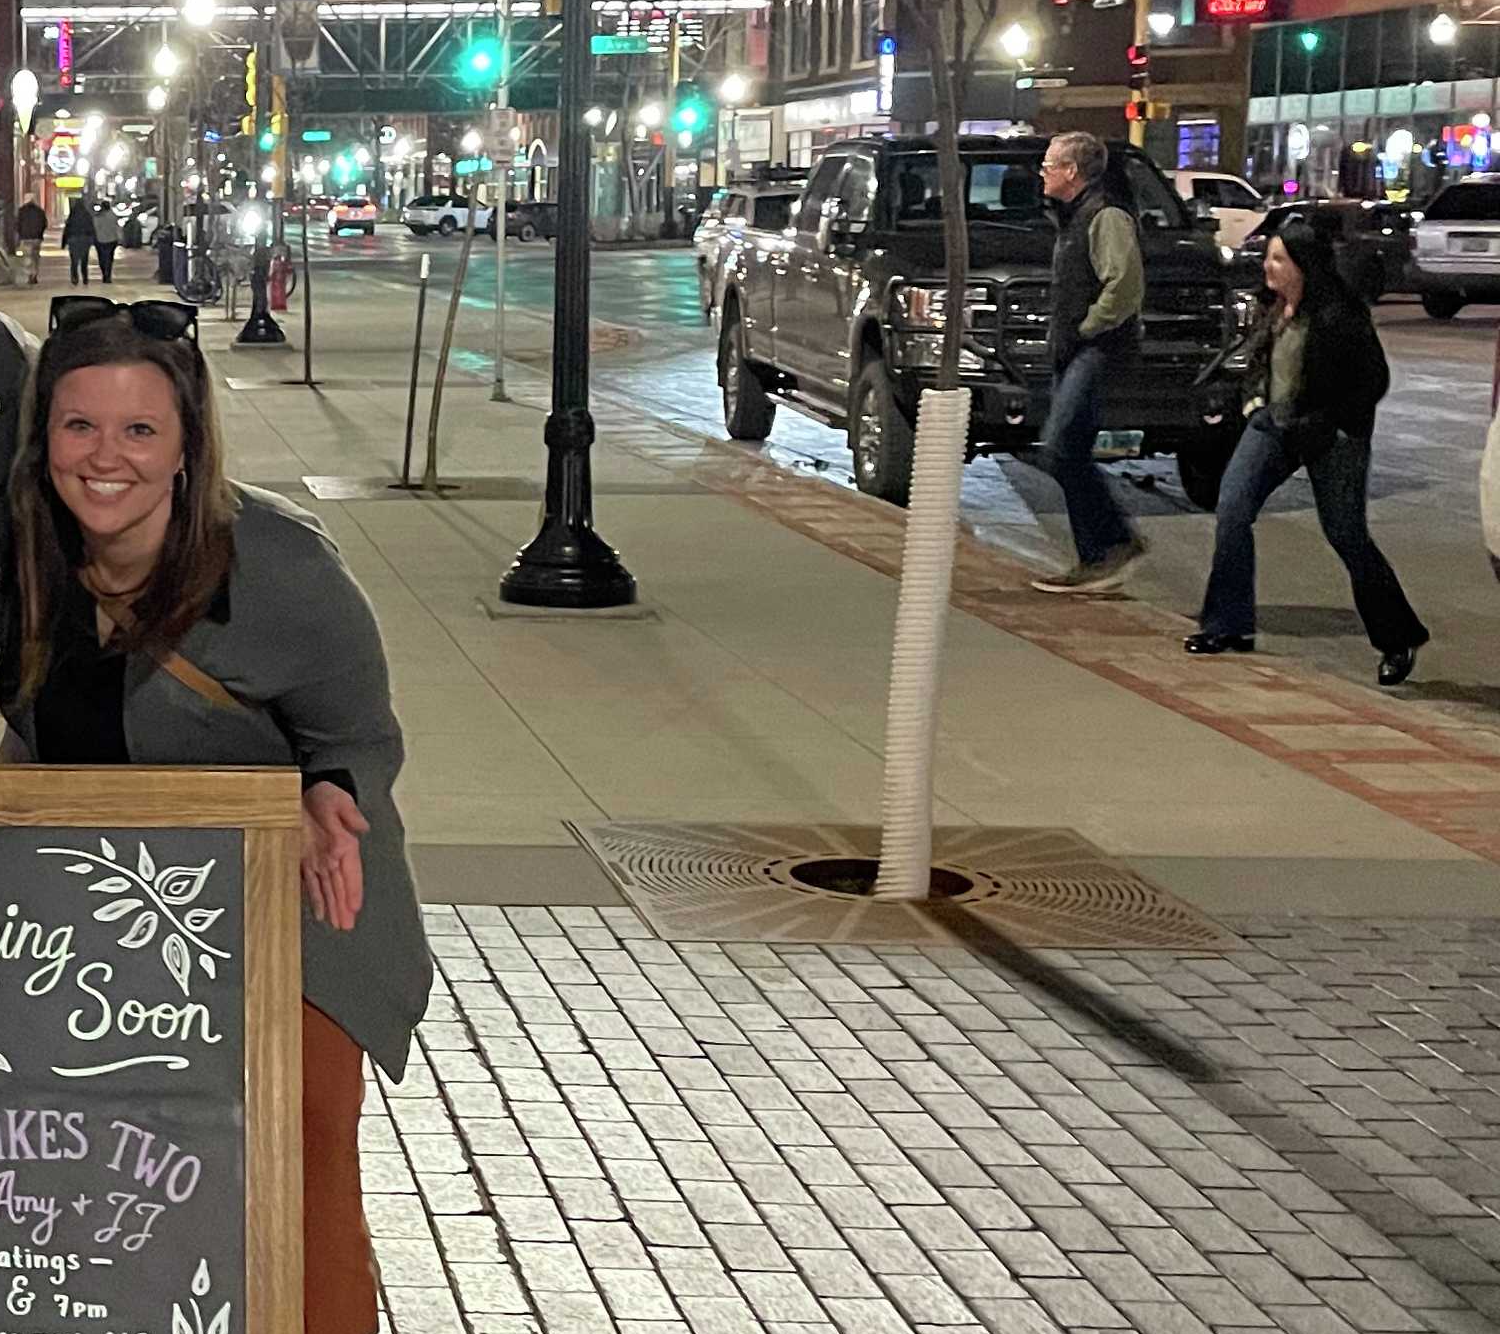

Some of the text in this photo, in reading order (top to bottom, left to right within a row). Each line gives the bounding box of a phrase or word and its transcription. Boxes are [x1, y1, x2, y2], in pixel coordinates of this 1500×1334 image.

[66, 961, 223, 1044] Soon
[106, 1120, 202, 1204] TWO
[6, 1275, 37, 1316] &
